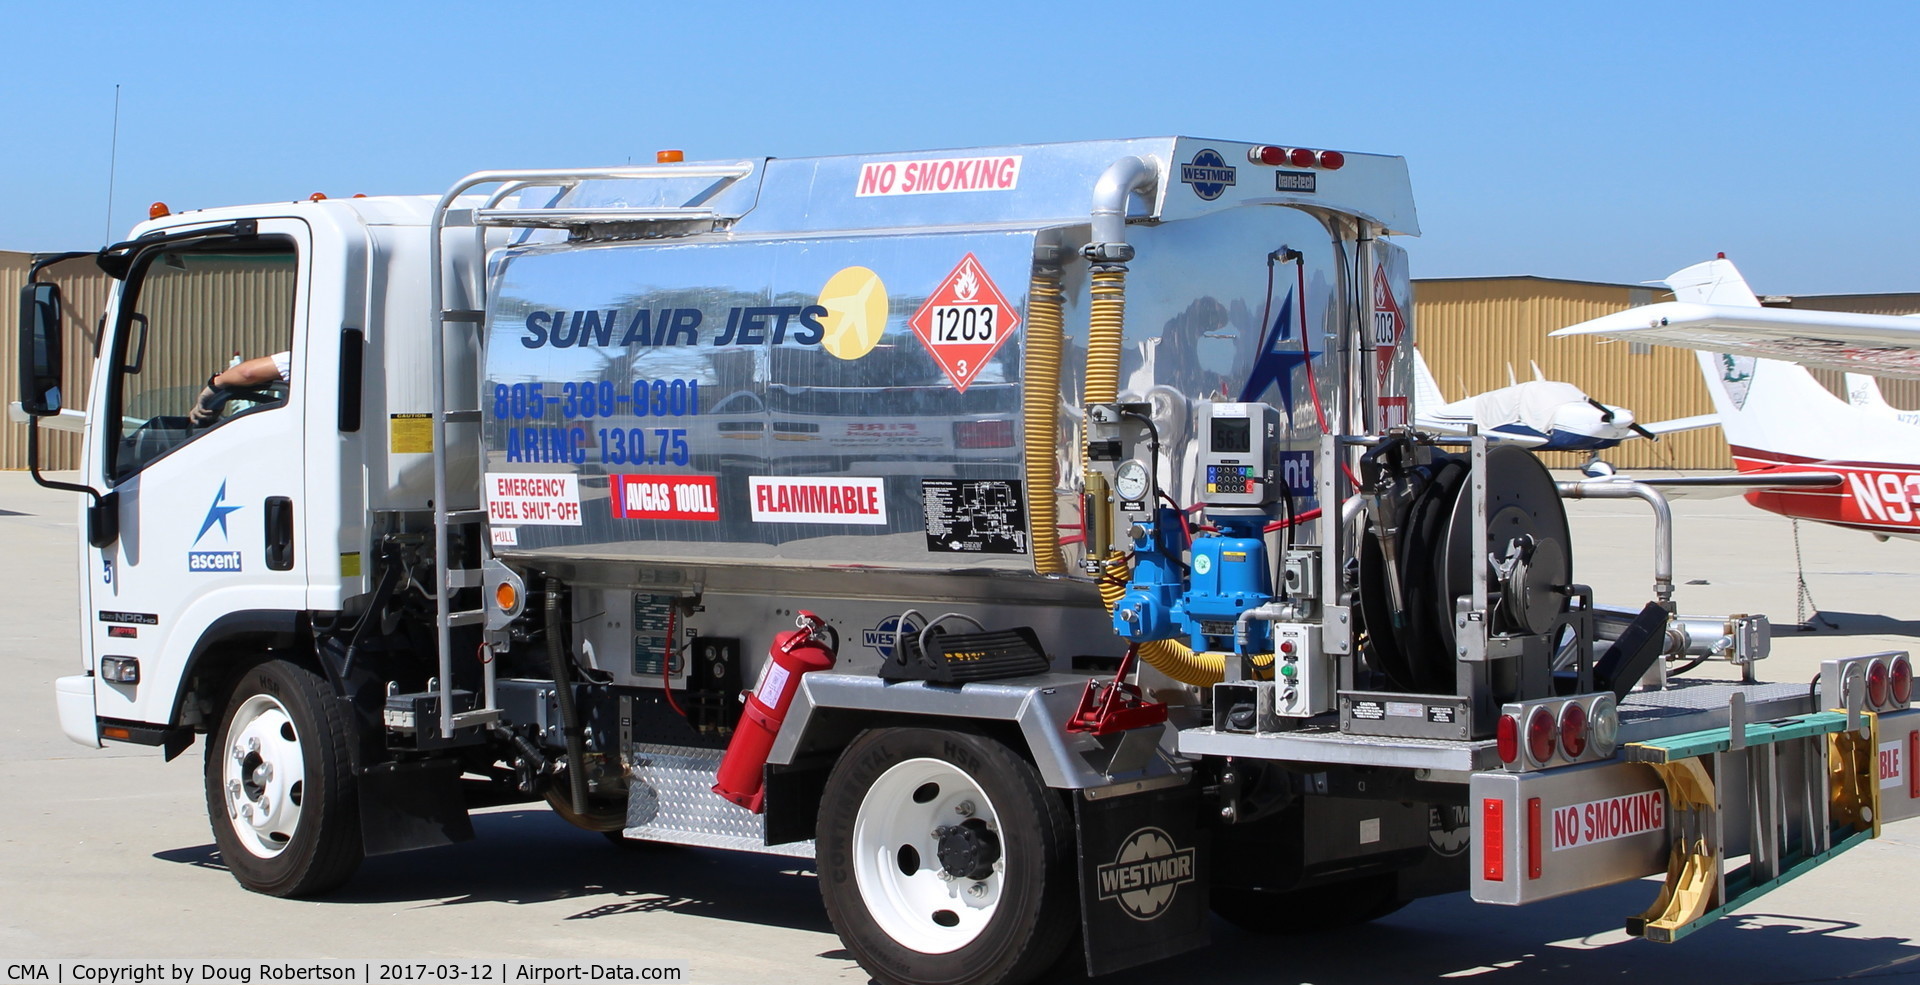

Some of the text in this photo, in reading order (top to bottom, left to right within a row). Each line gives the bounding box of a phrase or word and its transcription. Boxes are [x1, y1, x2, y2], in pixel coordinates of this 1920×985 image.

[860, 157, 1015, 194] NO SMOKING
[1183, 167, 1234, 182] WESTMOR
[520, 305, 829, 349] SUN AIR JETS
[936, 306, 993, 341] 1203
[1375, 312, 1394, 344] 203
[956, 359, 968, 377] 3
[1379, 360, 1385, 375] 3
[494, 378, 698, 420] 805-389-9301
[506, 427, 689, 466] ARINC 130.75
[497, 478, 566, 497] EMERGENCY
[626, 483, 715, 513] AVGAS 100LL
[756, 484, 880, 515] FLAMMABLE
[490, 501, 579, 521] FUEL SHUT-OFF
[494, 530, 515, 543] PULL
[104, 560, 112, 584] 5
[190, 551, 240, 569] ascent
[115, 613, 143, 623] NPR
[943, 739, 982, 774] HSR
[1554, 791, 1662, 848] NO SMOKING
[1101, 855, 1191, 893] WESTMOR
